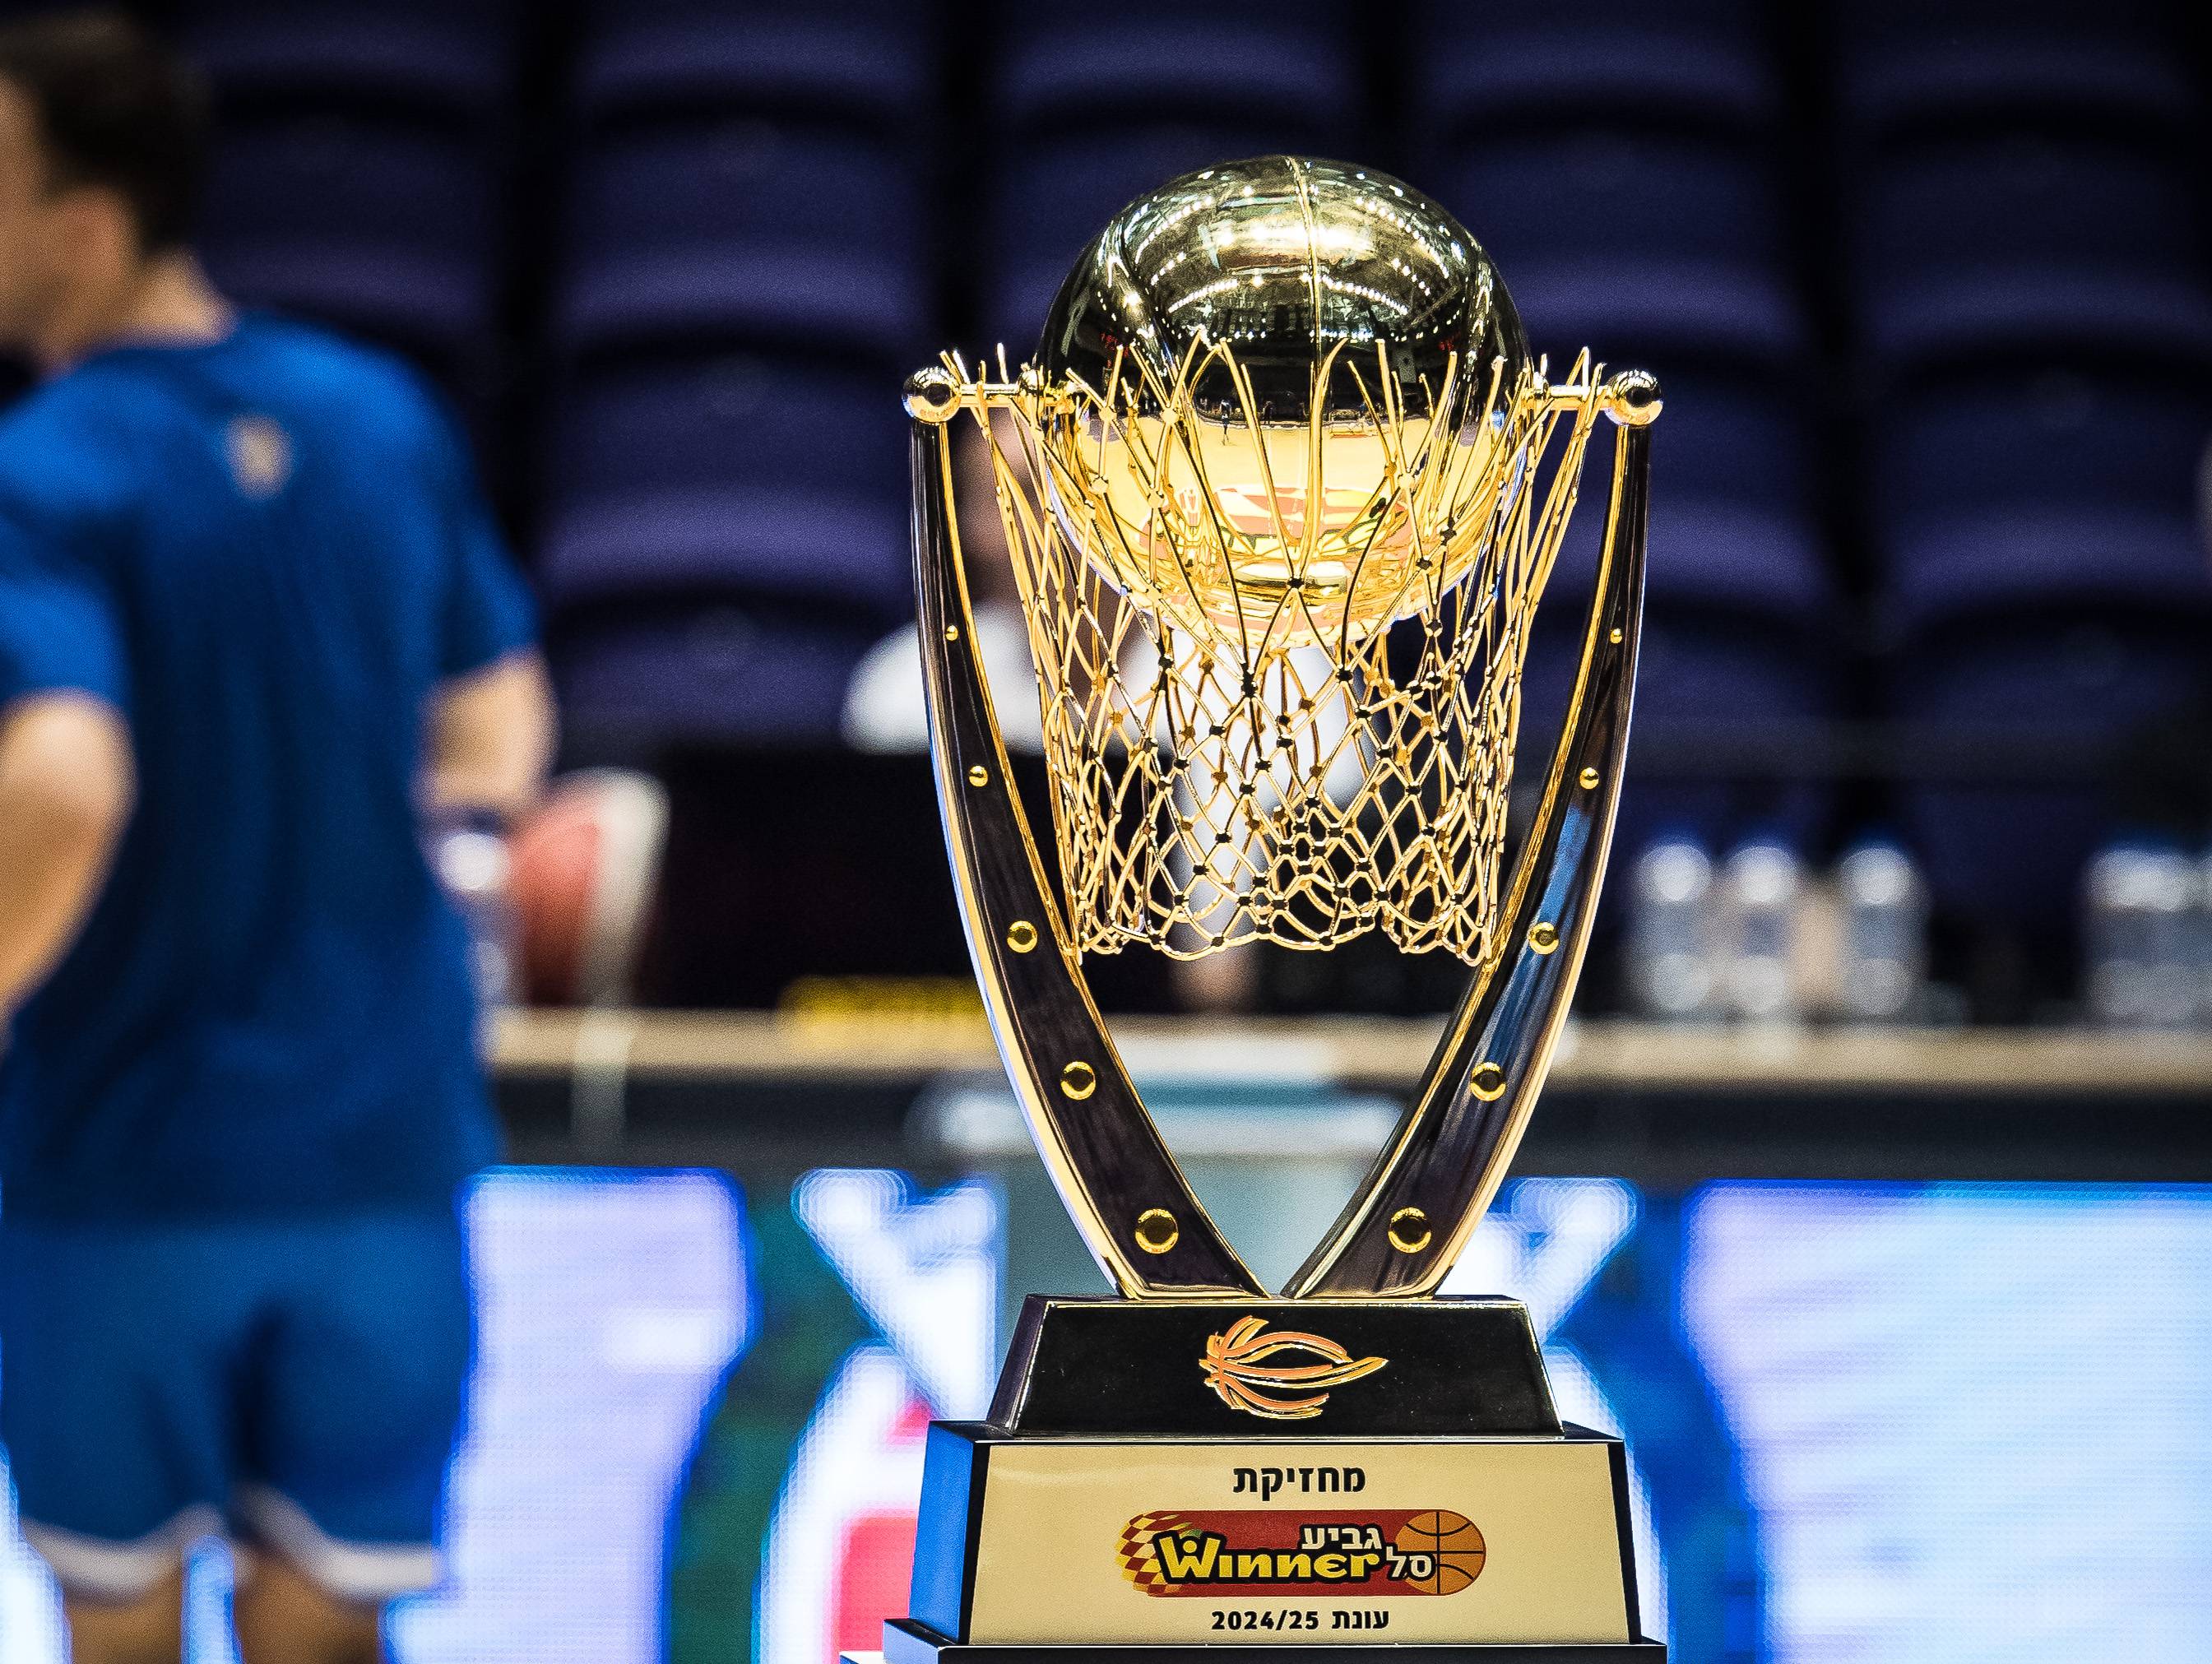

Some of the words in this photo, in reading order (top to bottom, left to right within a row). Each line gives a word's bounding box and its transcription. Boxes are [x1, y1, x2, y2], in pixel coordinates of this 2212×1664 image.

[1233, 1467, 1366, 1501] מחזיקת
[1301, 1527, 1382, 1550] גביע
[1158, 1536, 1380, 1578] Winner
[1386, 1546, 1432, 1578] סל
[1212, 1611, 1318, 1631] 2024/25
[1332, 1611, 1389, 1629] עונת
